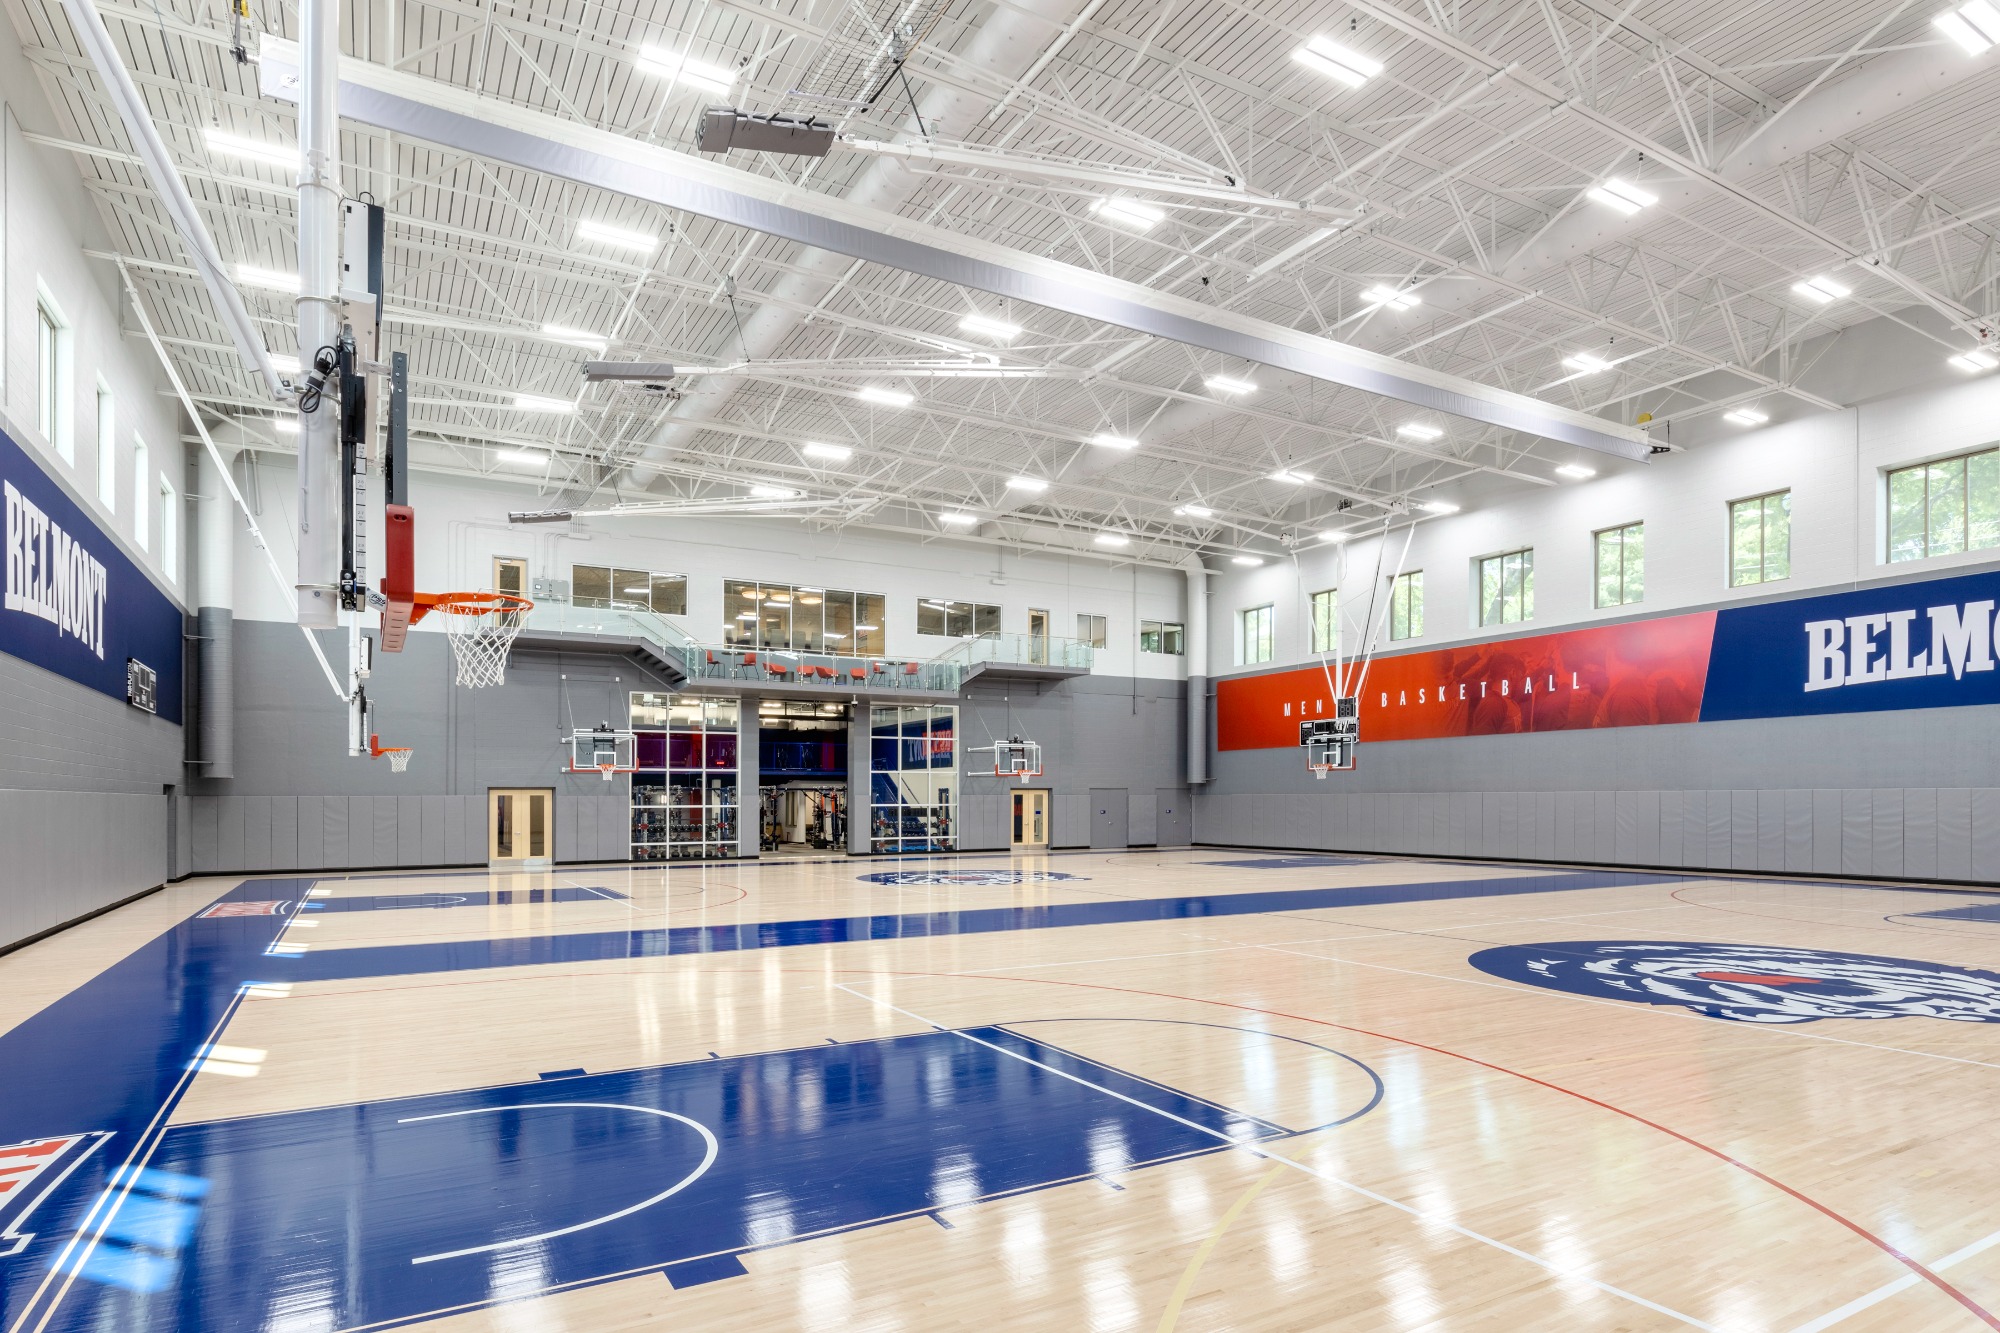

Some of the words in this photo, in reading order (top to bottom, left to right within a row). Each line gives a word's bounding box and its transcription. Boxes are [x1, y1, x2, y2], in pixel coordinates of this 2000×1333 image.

[4, 479, 107, 660] BELMONT
[1804, 600, 2000, 692] BELM
[1284, 699, 1323, 717] MEN
[1381, 672, 1580, 708] BASKETBALL
